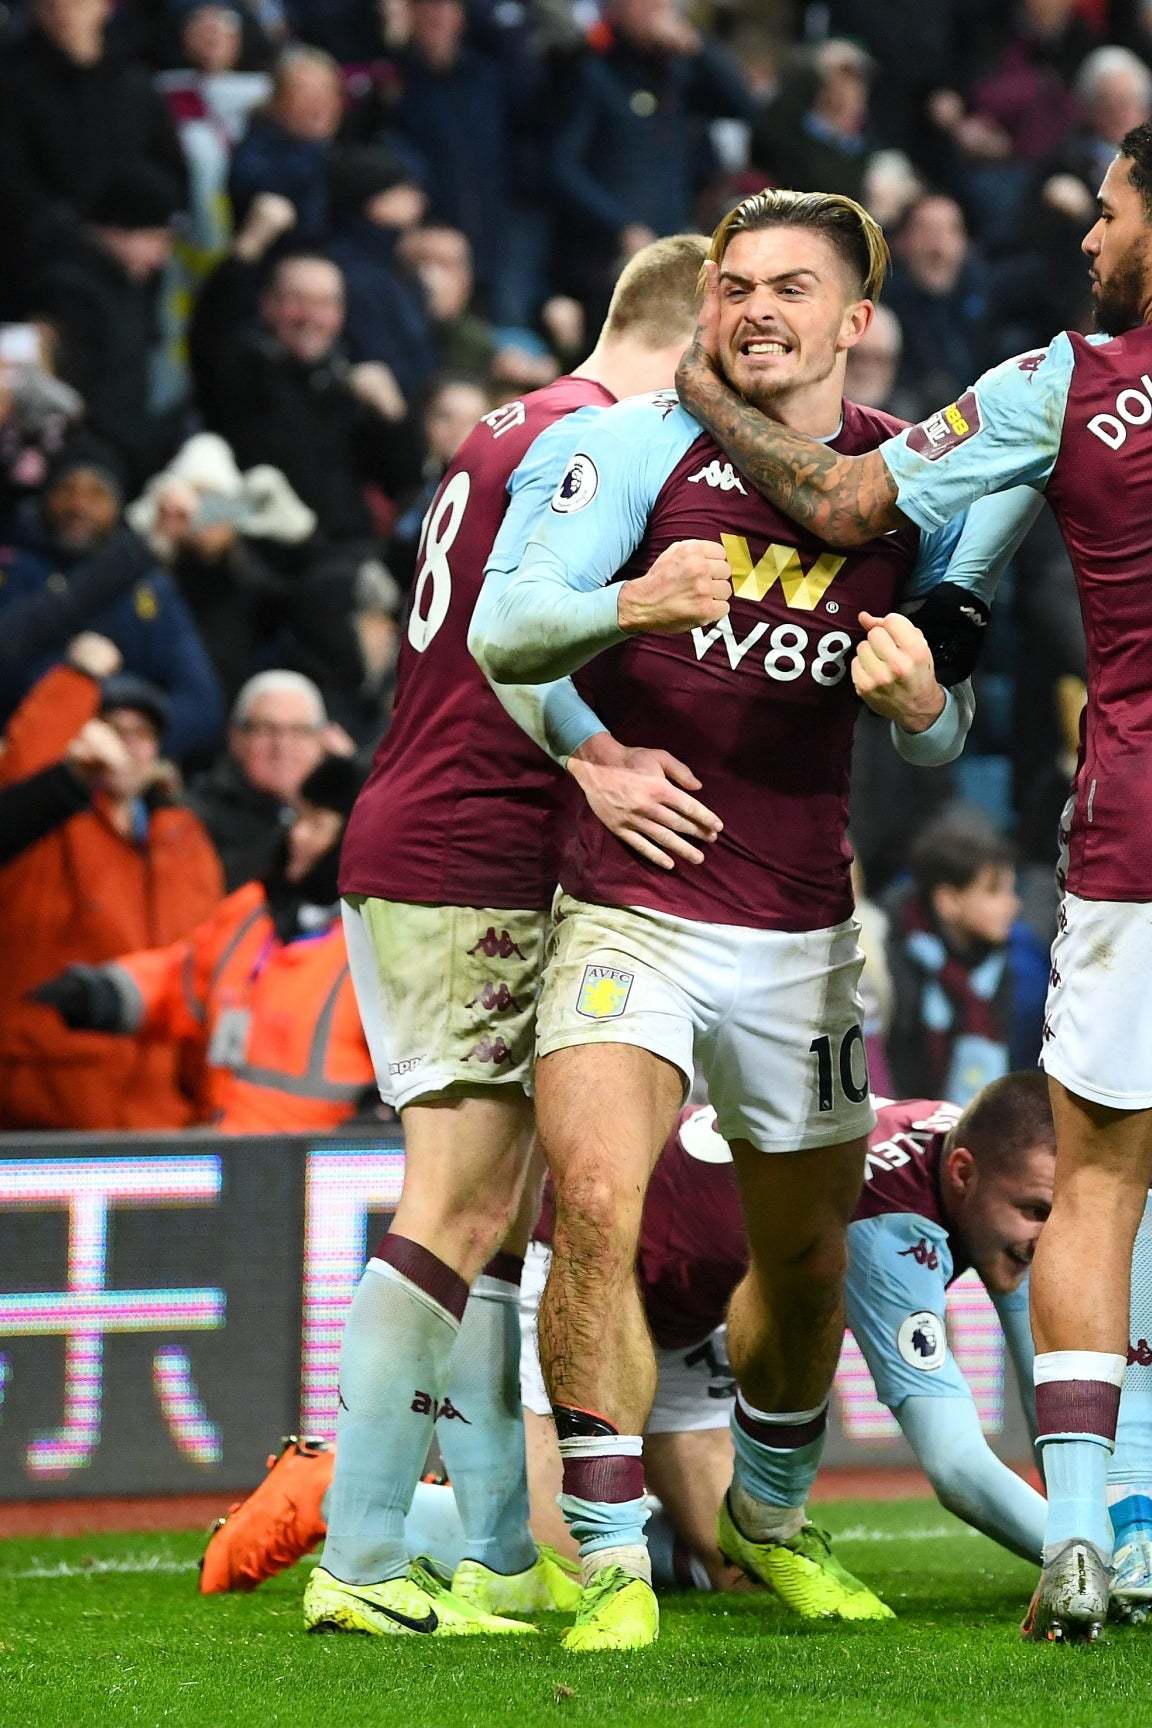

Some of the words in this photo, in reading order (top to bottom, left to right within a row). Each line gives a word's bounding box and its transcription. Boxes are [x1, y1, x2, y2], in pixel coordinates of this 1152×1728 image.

[690, 614, 852, 688] W88
[588, 968, 631, 984] AVFC
[809, 1024, 868, 1112] 10
